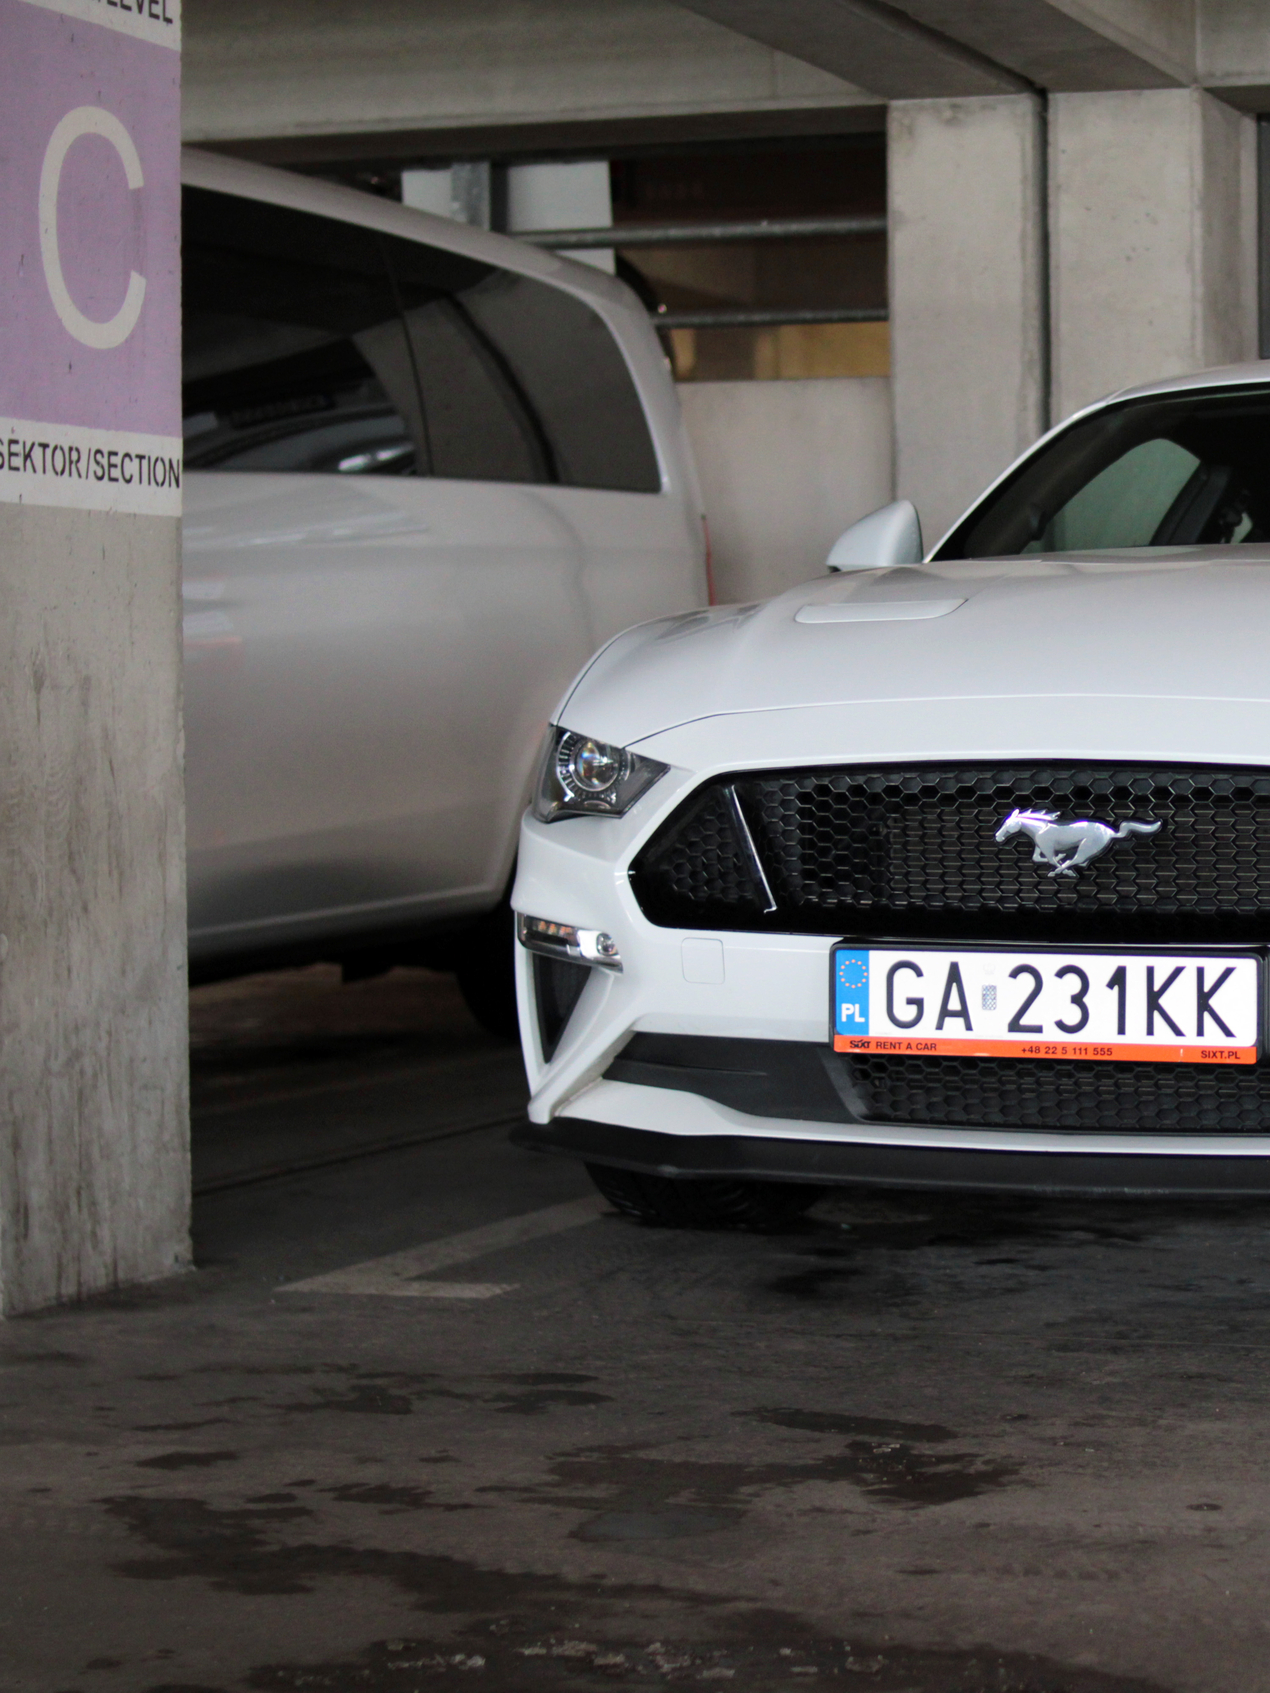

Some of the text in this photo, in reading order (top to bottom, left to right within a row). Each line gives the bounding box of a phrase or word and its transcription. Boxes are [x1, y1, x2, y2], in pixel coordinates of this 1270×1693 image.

[38, 105, 147, 349] C
[841, 1003, 866, 1023] PL
[885, 959, 1238, 1039] GA 231KK
[876, 1041, 902, 1050] RENT
[916, 1043, 937, 1051] CAR
[1021, 1045, 1041, 1054] +48
[1044, 1045, 1058, 1055] 22
[1061, 1046, 1068, 1055] 5
[1072, 1047, 1088, 1056] 111
[1093, 1047, 1113, 1056] 555
[1200, 1049, 1241, 1060] SIXT.PL
